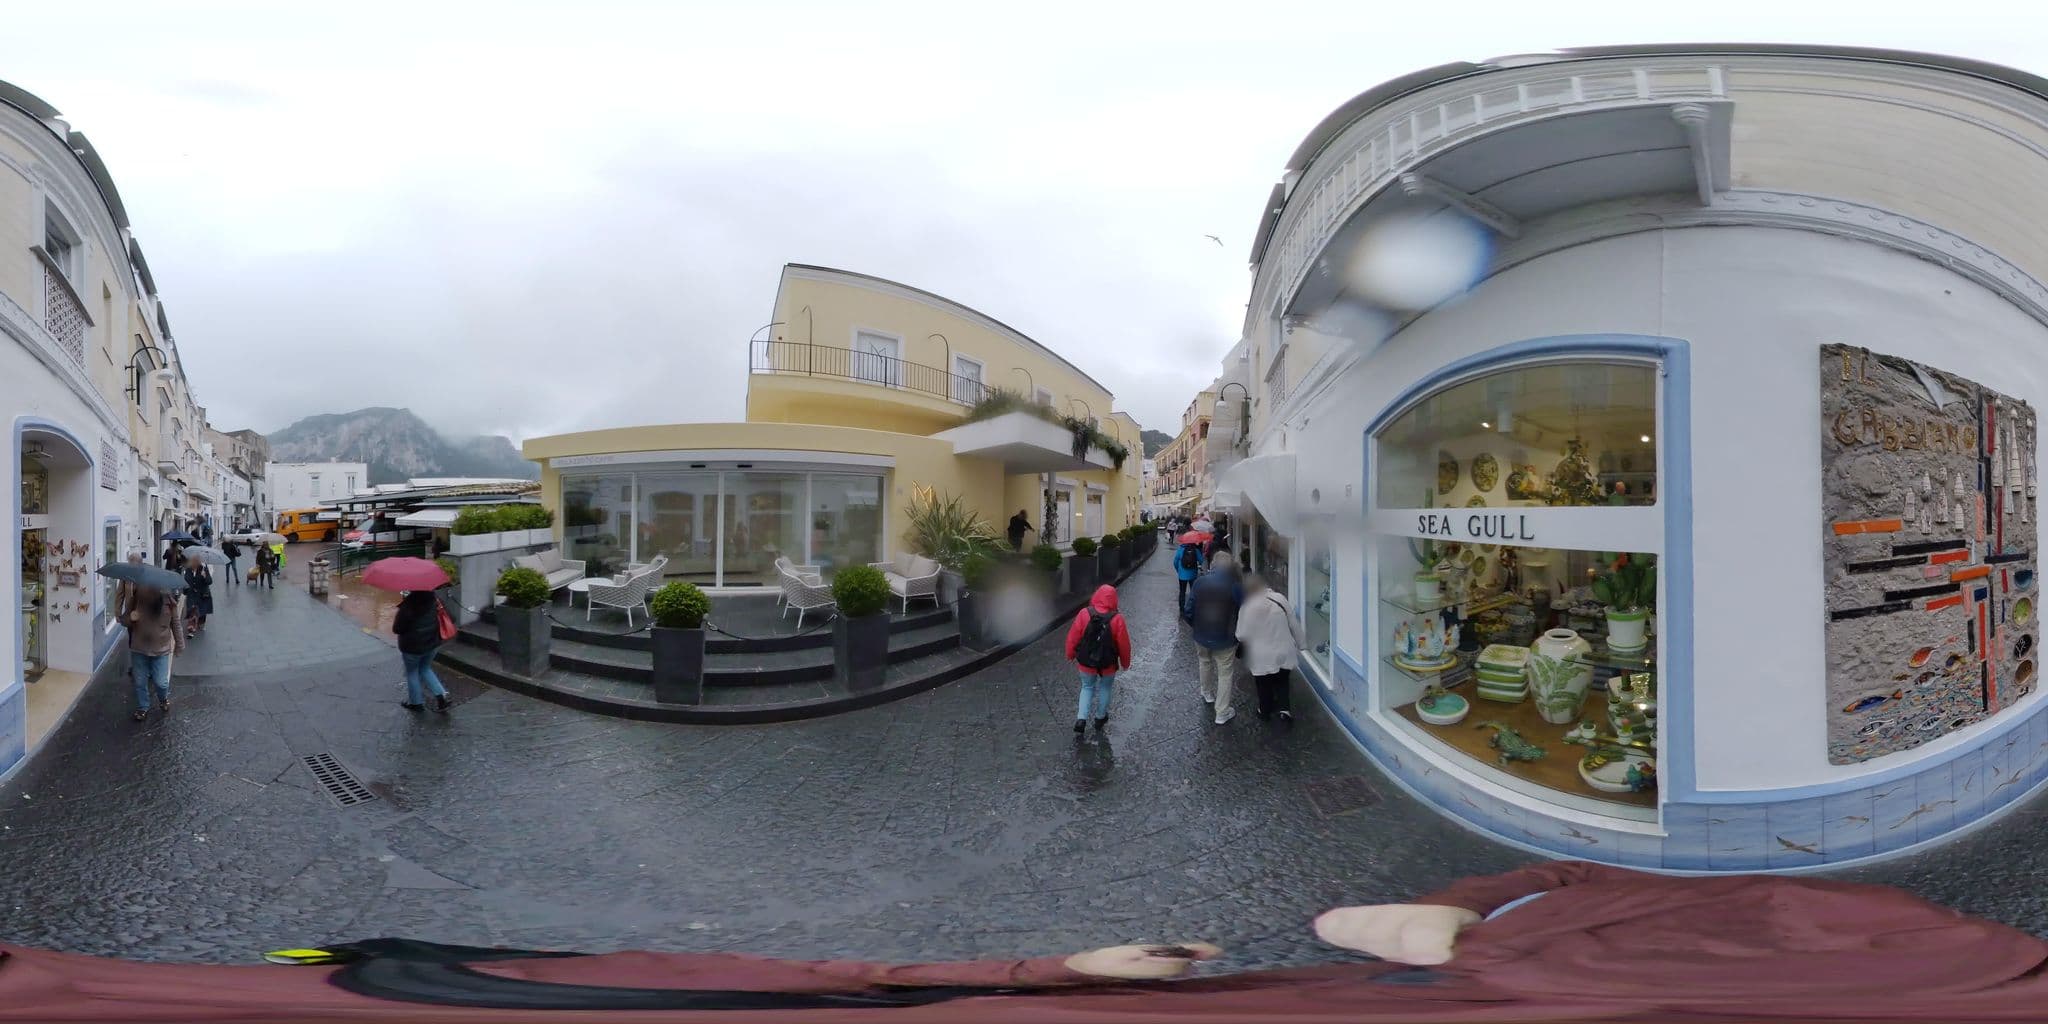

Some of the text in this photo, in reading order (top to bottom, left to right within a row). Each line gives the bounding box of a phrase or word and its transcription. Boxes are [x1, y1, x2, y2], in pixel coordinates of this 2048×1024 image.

[1841, 350, 1876, 385] IL
[20, 516, 32, 527] LL
[1418, 514, 1535, 540] SEA GULL
